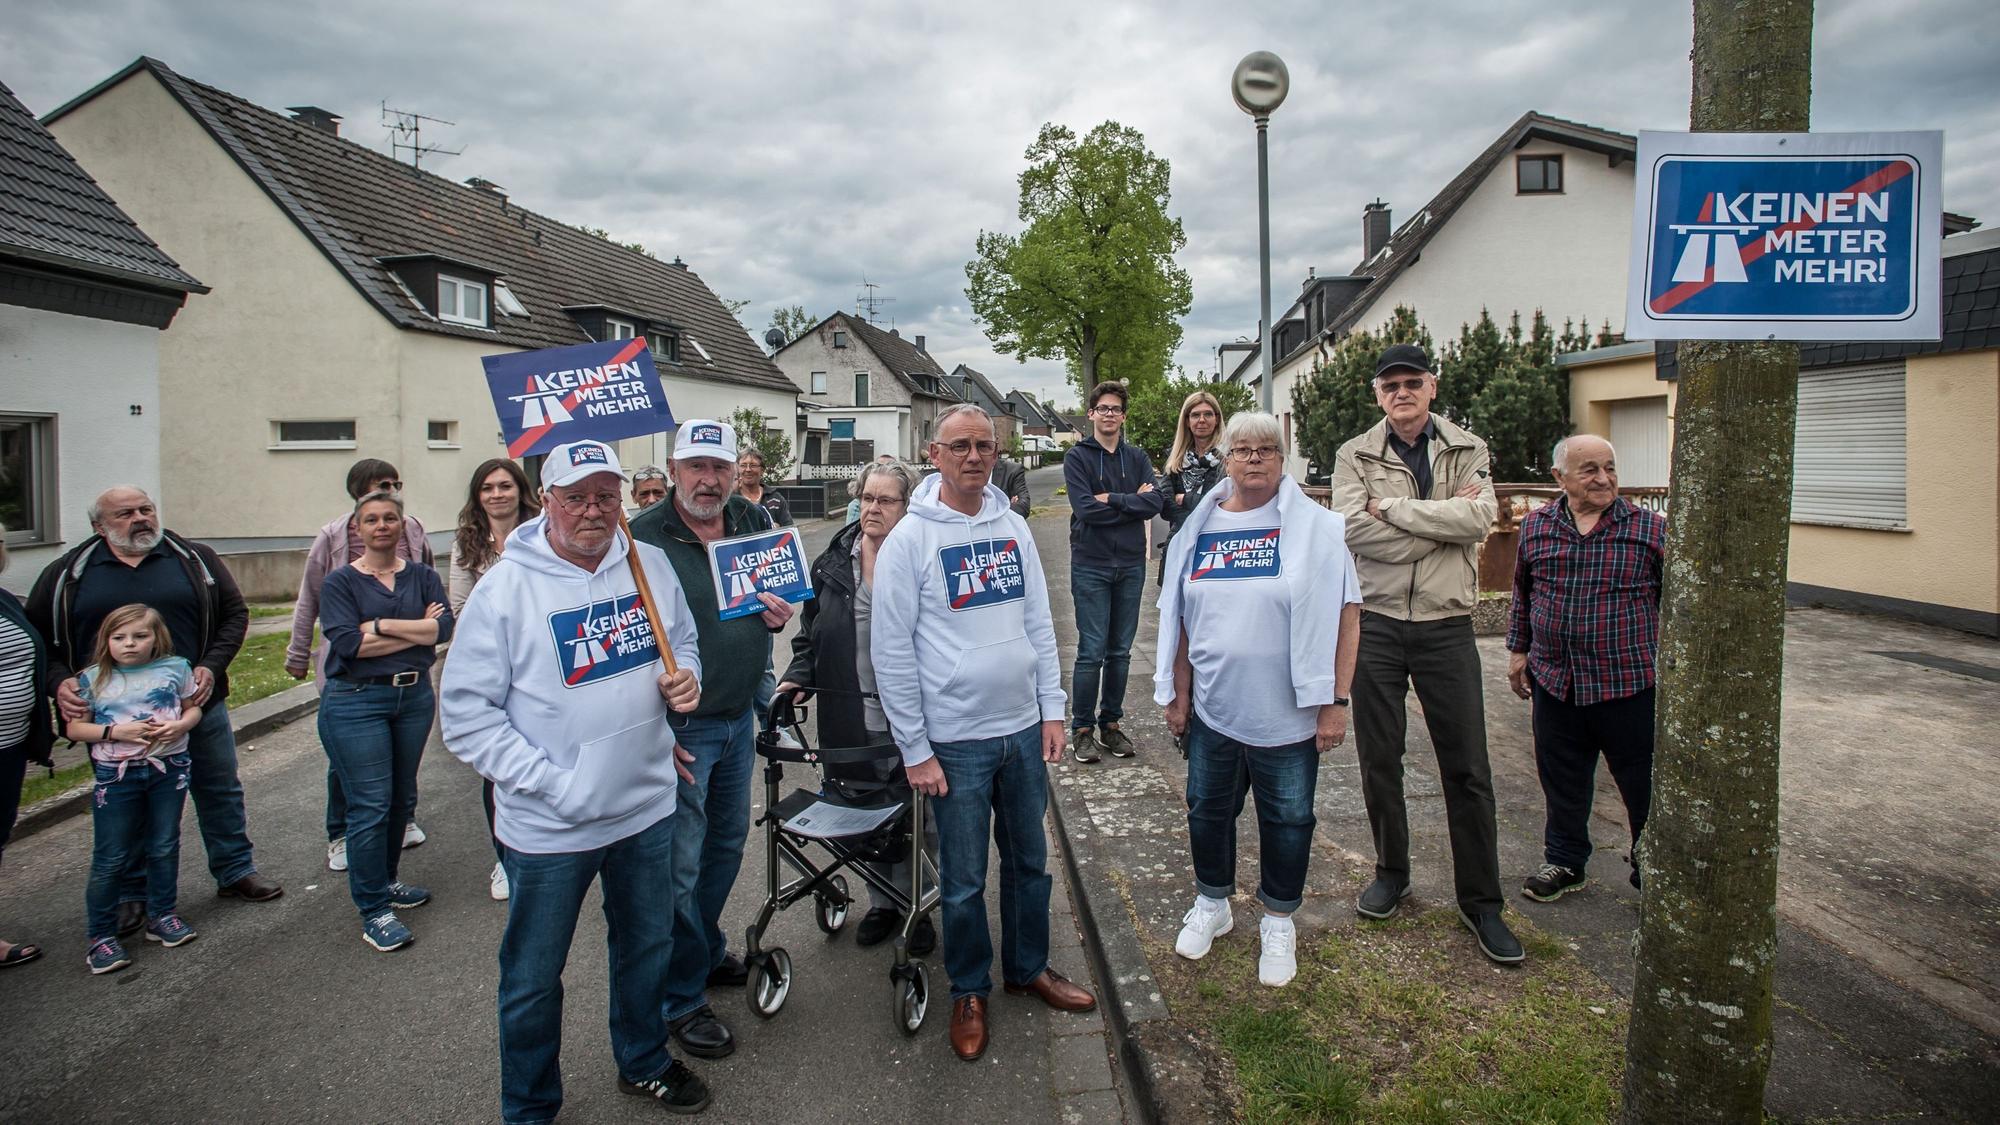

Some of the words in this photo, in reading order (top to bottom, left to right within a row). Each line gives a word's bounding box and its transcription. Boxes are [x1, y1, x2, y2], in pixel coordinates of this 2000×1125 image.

[1716, 192, 1889, 223] KEINEN
[1764, 230, 1887, 253] METER
[1774, 258, 1887, 283] MEHR!
[534, 361, 642, 392] KEINEN
[573, 381, 647, 403] METER
[586, 398, 653, 418] MEHR!
[1216, 537, 1277, 551] KEINEN
[1231, 549, 1274, 559] METER
[735, 545, 793, 569] KEINEN
[964, 551, 1017, 569] KEINEN
[1233, 558, 1273, 568] MEHR!
[755, 560, 796, 578] METER
[762, 571, 799, 590] MEHR!
[582, 607, 649, 637] KEINEN
[608, 622, 652, 645] METER
[616, 633, 656, 656] MEHR!
